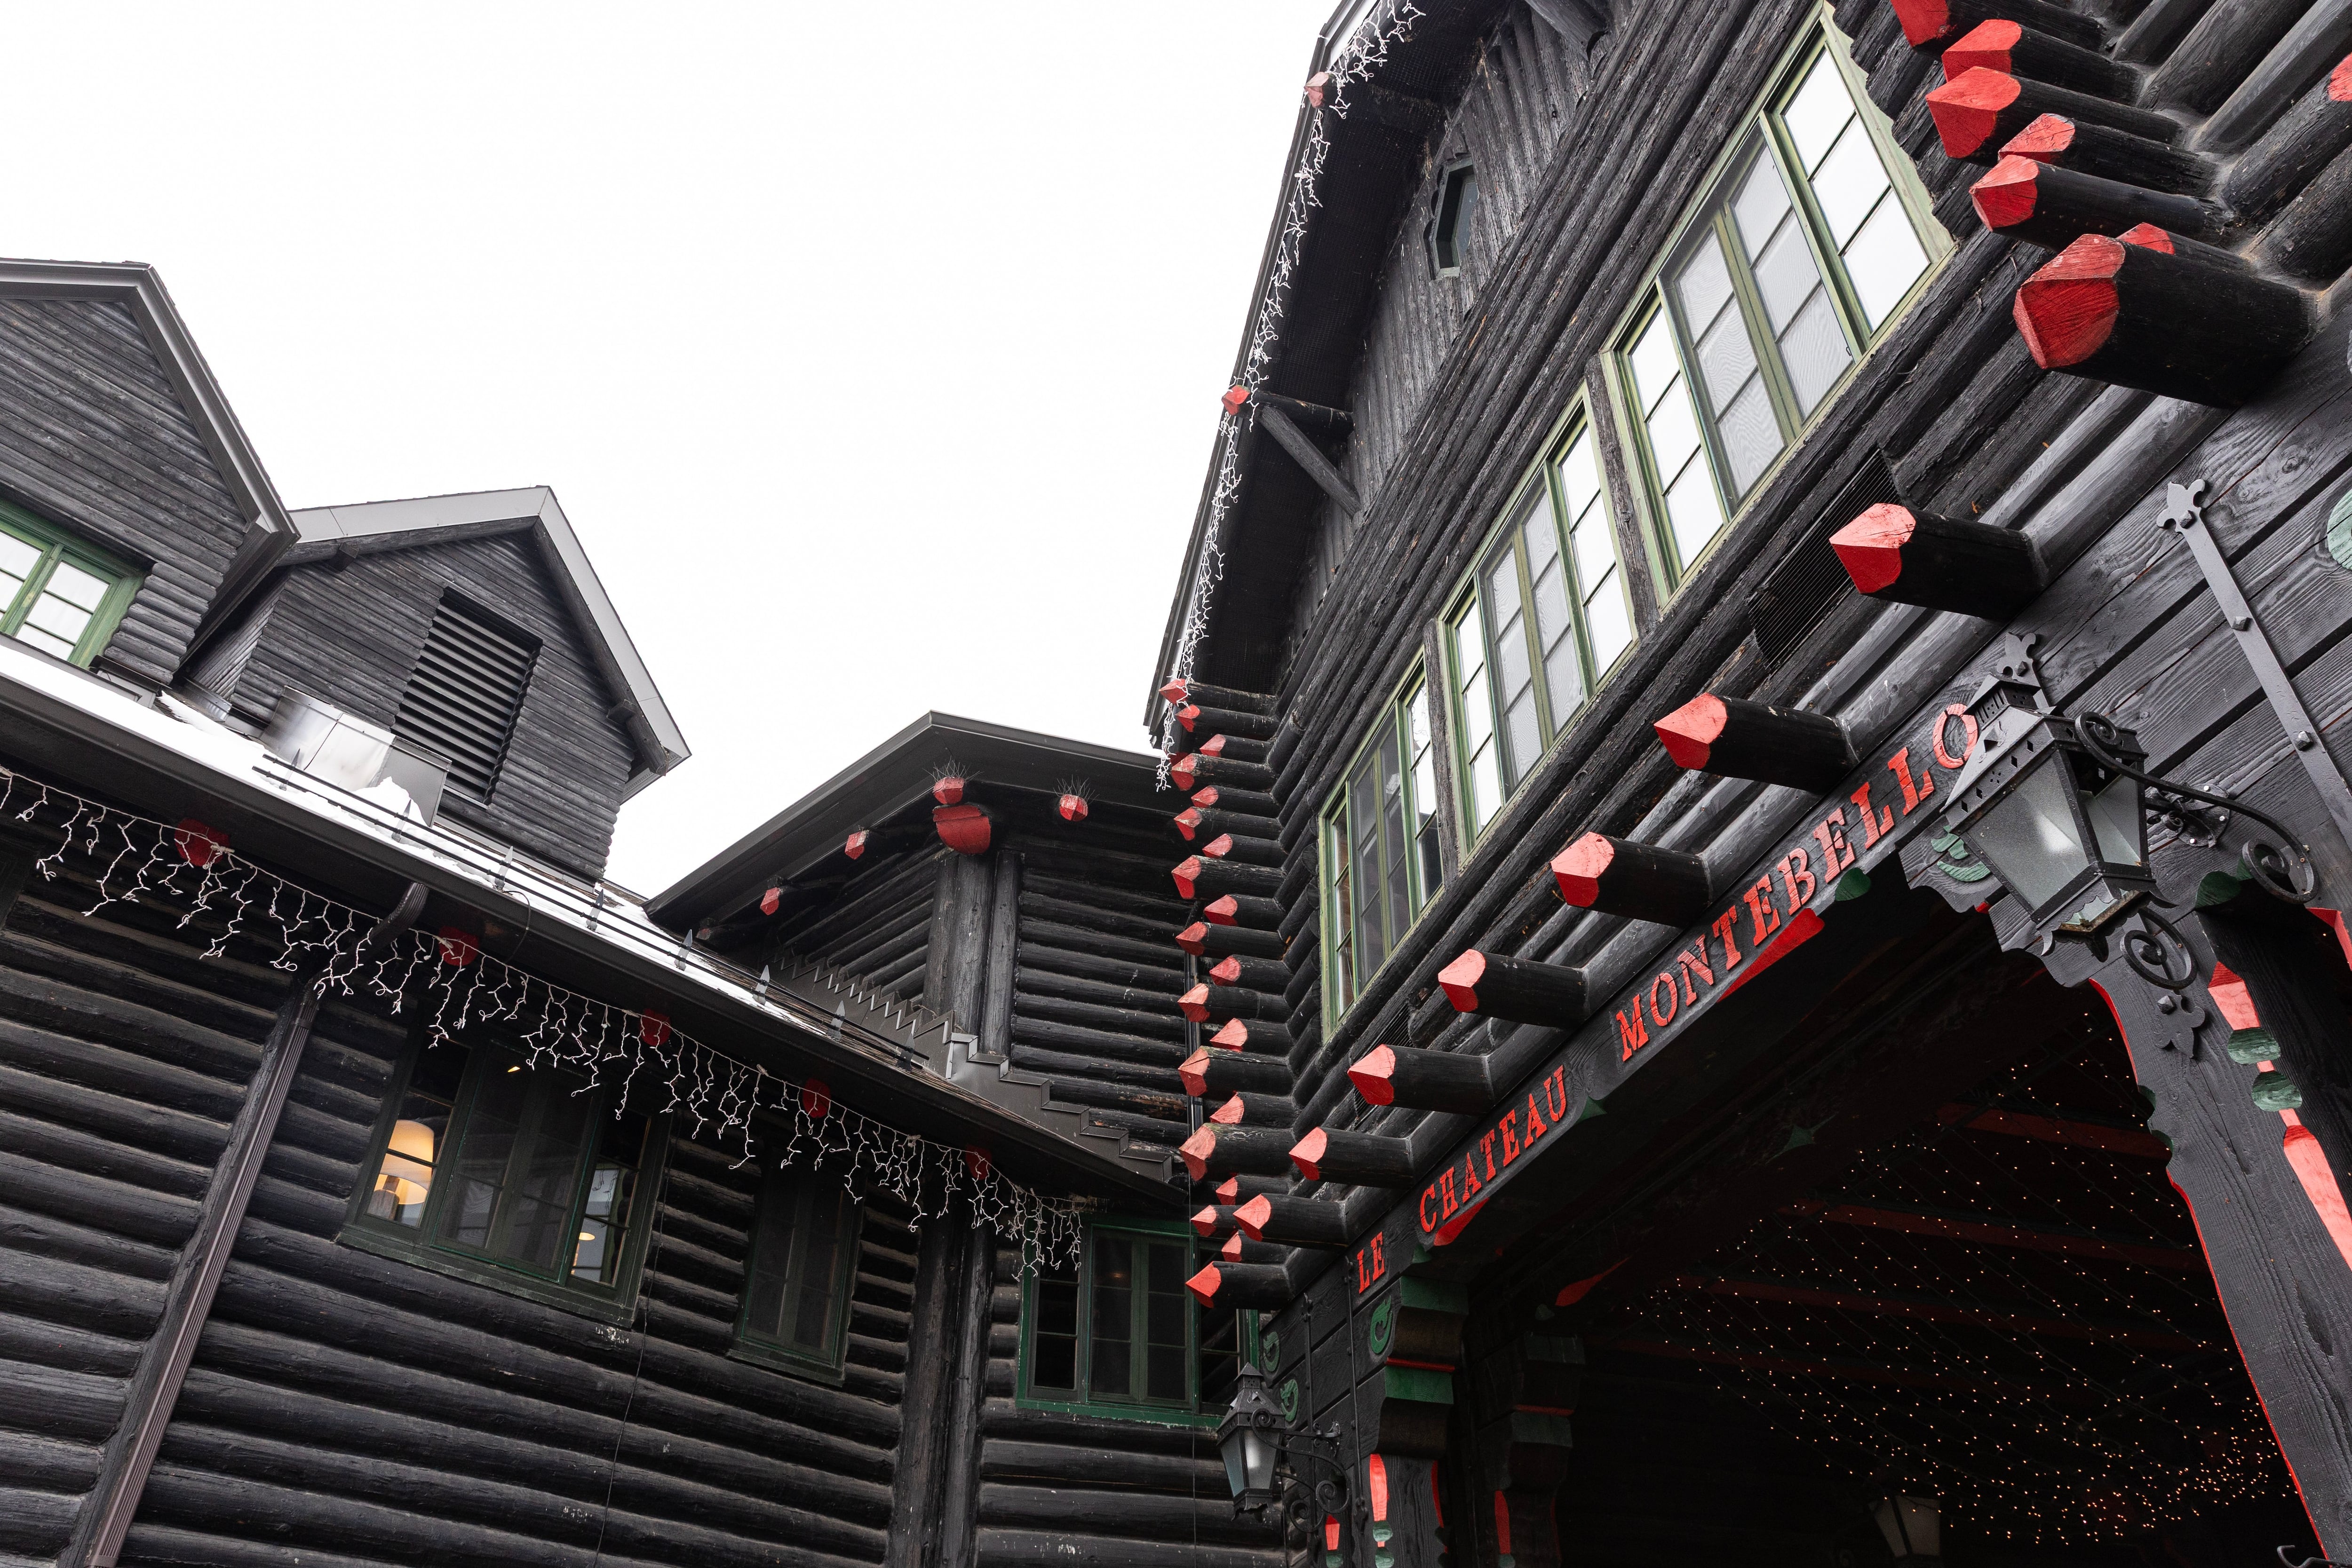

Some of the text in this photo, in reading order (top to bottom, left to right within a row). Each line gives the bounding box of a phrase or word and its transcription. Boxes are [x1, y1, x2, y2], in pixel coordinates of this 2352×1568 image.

[1357, 703, 1979, 1294] LE CHATEAU MONTEBELLO
